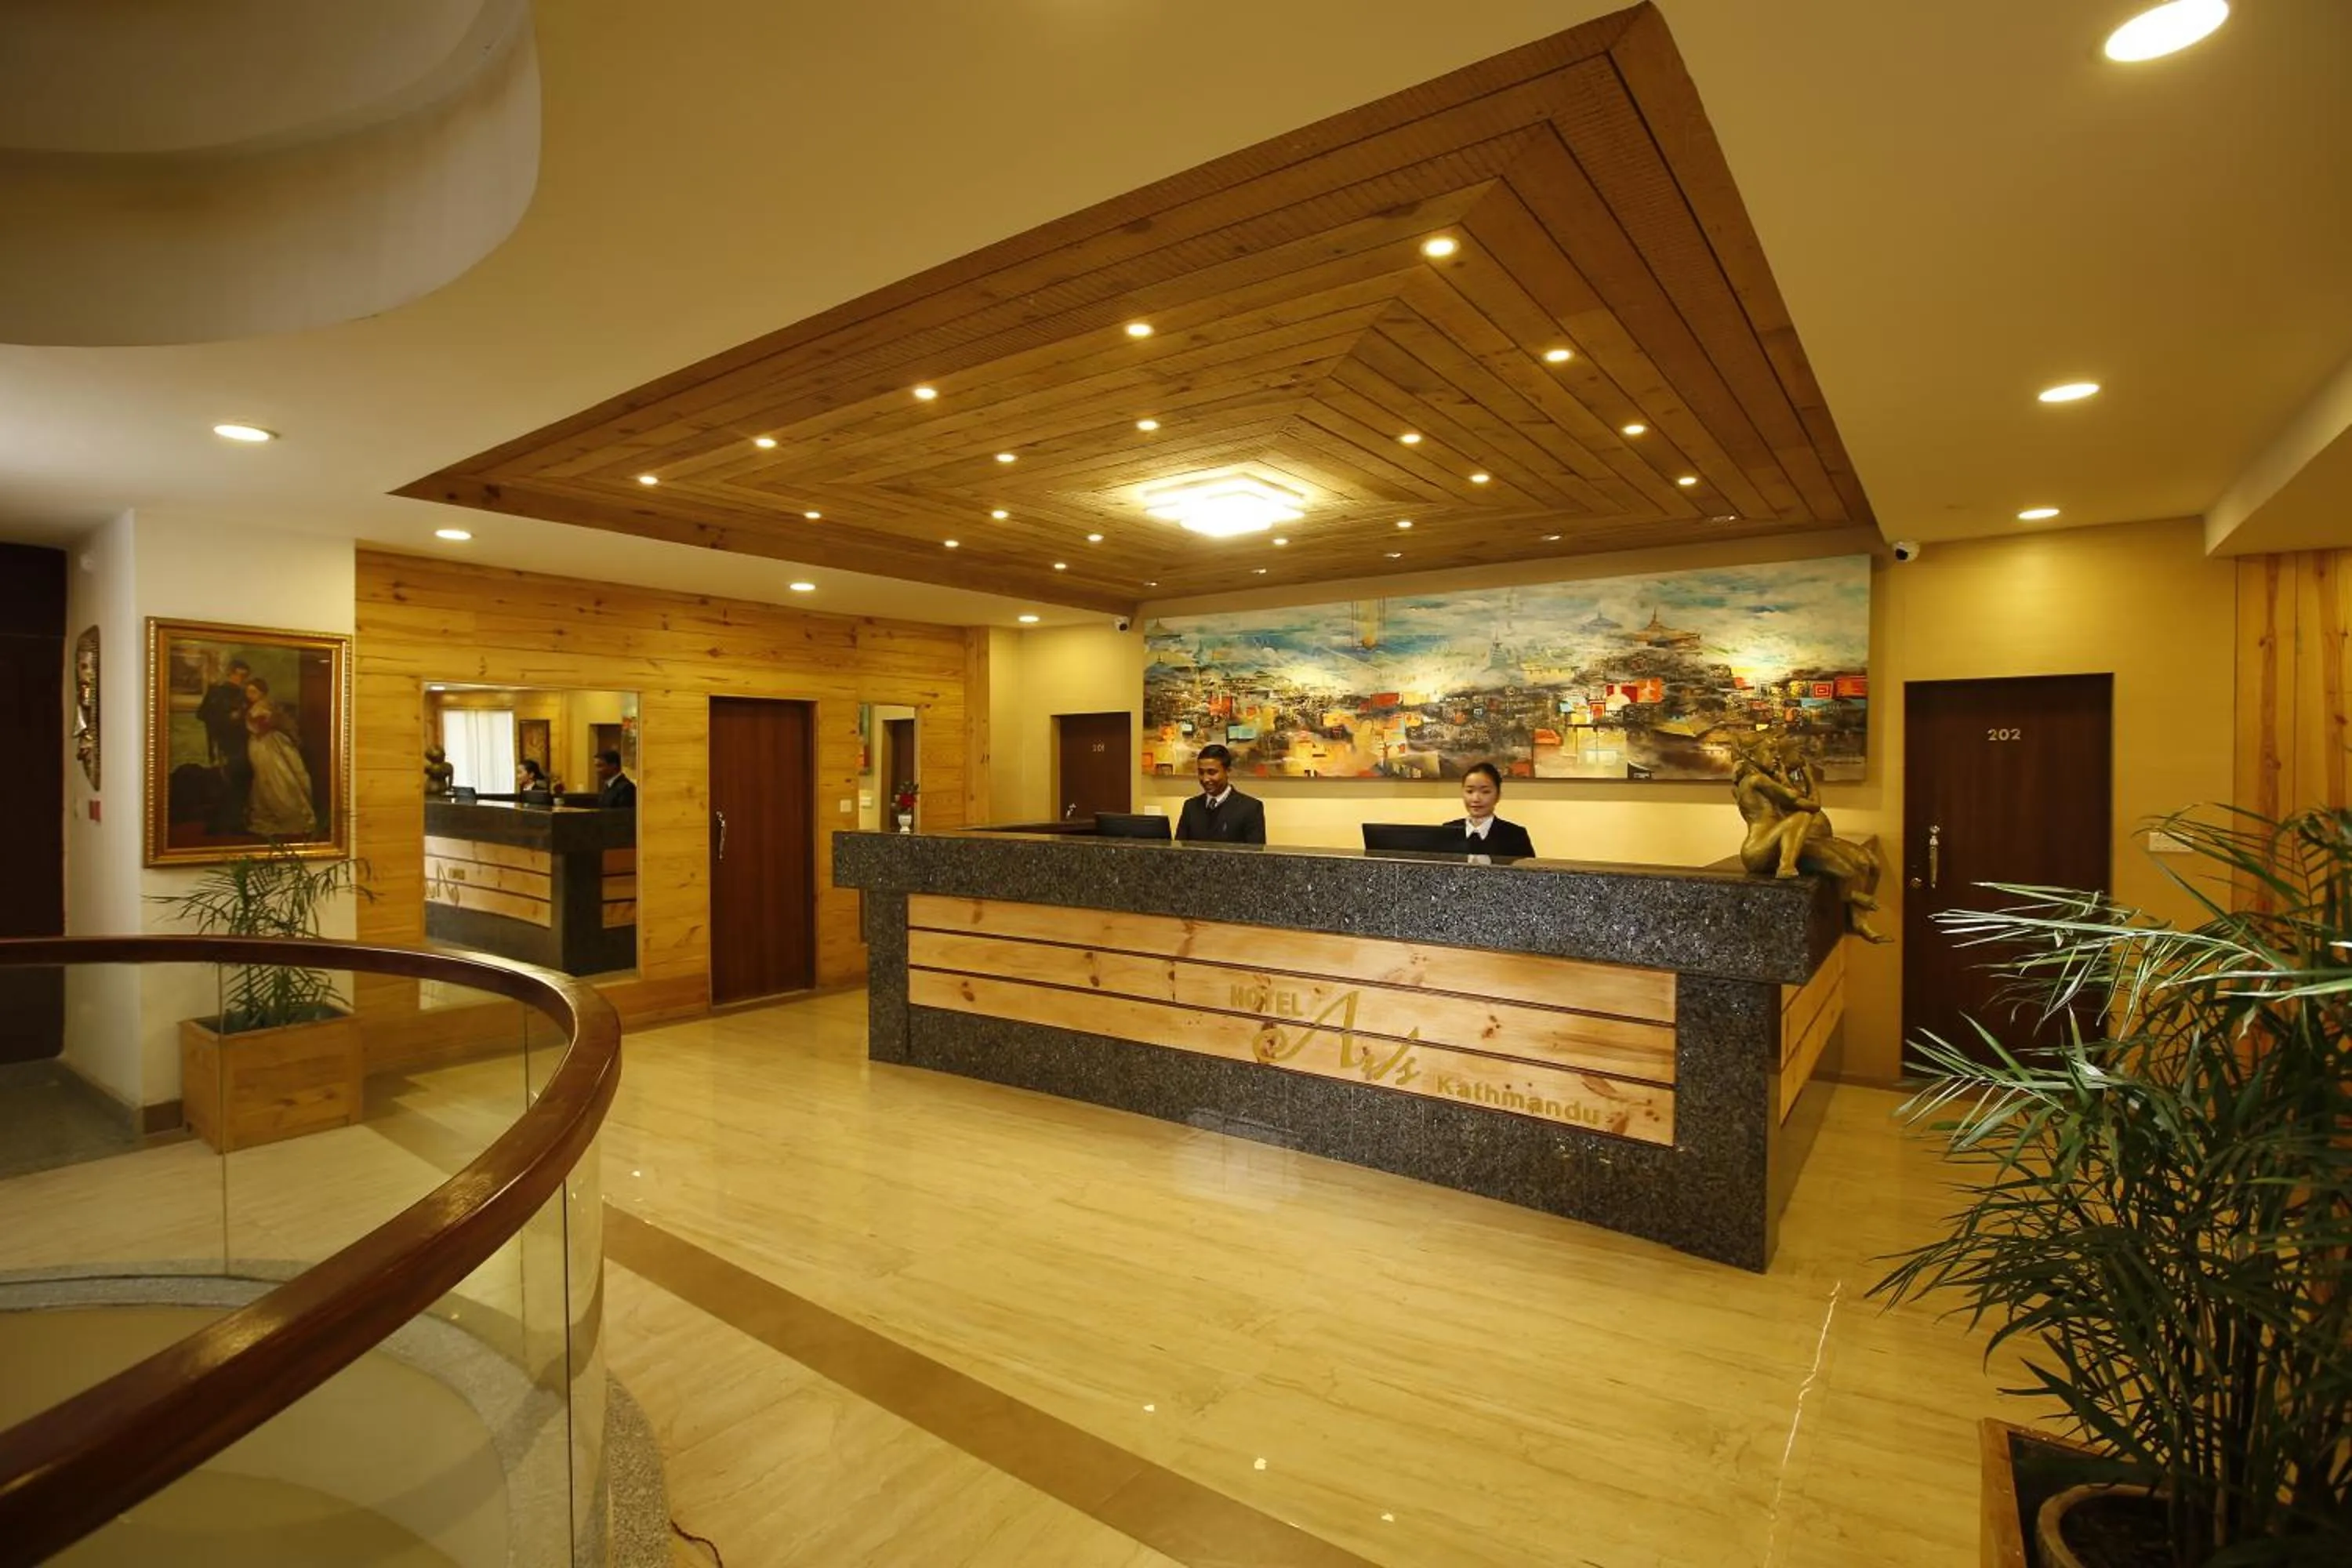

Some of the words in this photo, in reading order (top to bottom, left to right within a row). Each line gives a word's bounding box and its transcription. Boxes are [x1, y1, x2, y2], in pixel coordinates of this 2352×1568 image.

[1987, 728, 2020, 741] 202
[1230, 985, 1304, 1016] HOTEL
[1436, 1075, 1600, 1125] Kathmandu
